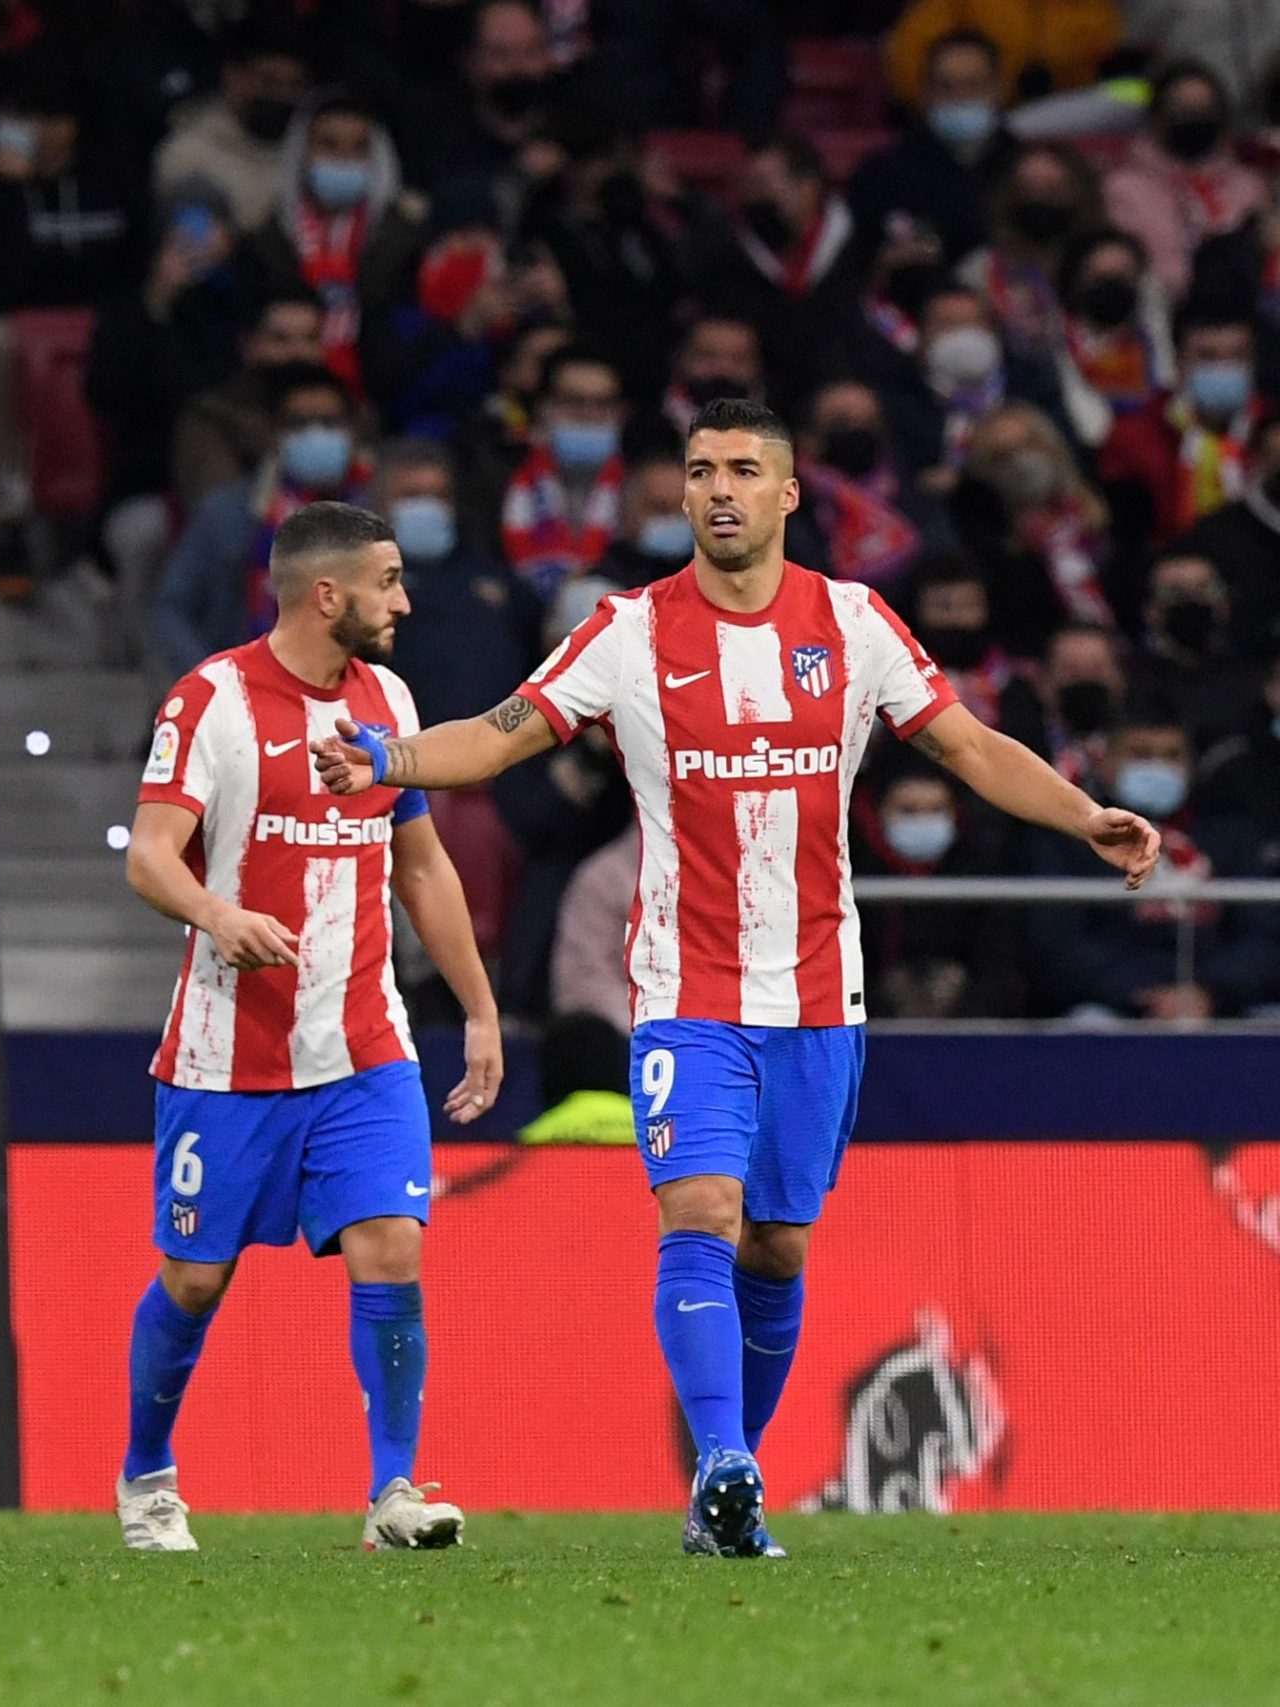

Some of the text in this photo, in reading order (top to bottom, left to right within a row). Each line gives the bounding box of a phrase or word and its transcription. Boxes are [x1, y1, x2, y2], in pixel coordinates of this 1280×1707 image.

[674, 736, 838, 780] Plus500
[641, 1048, 675, 1117] 9
[171, 1131, 203, 1196] 6
